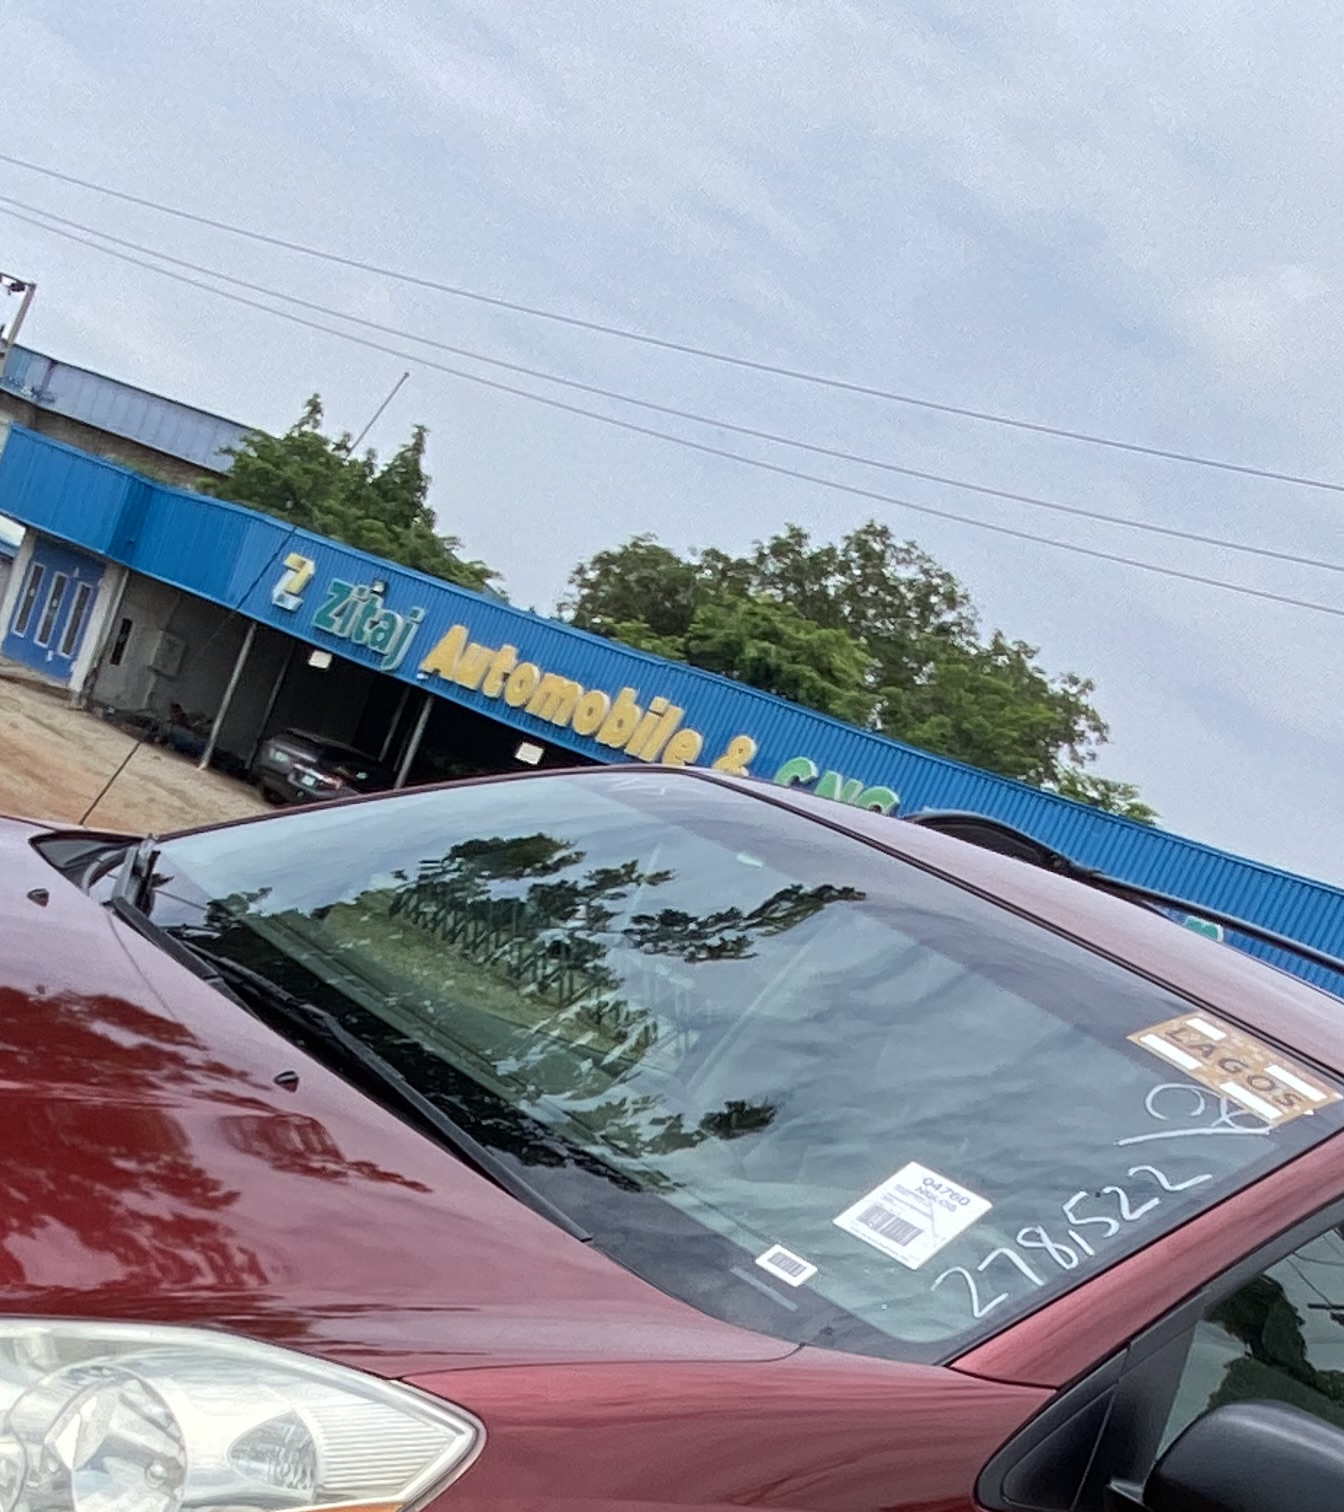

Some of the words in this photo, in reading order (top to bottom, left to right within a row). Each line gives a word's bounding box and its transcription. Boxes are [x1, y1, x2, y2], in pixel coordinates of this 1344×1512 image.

[419, 624, 704, 766] Automobile
[712, 735, 757, 777] &
[1164, 1026, 1303, 1108] LAGOS
